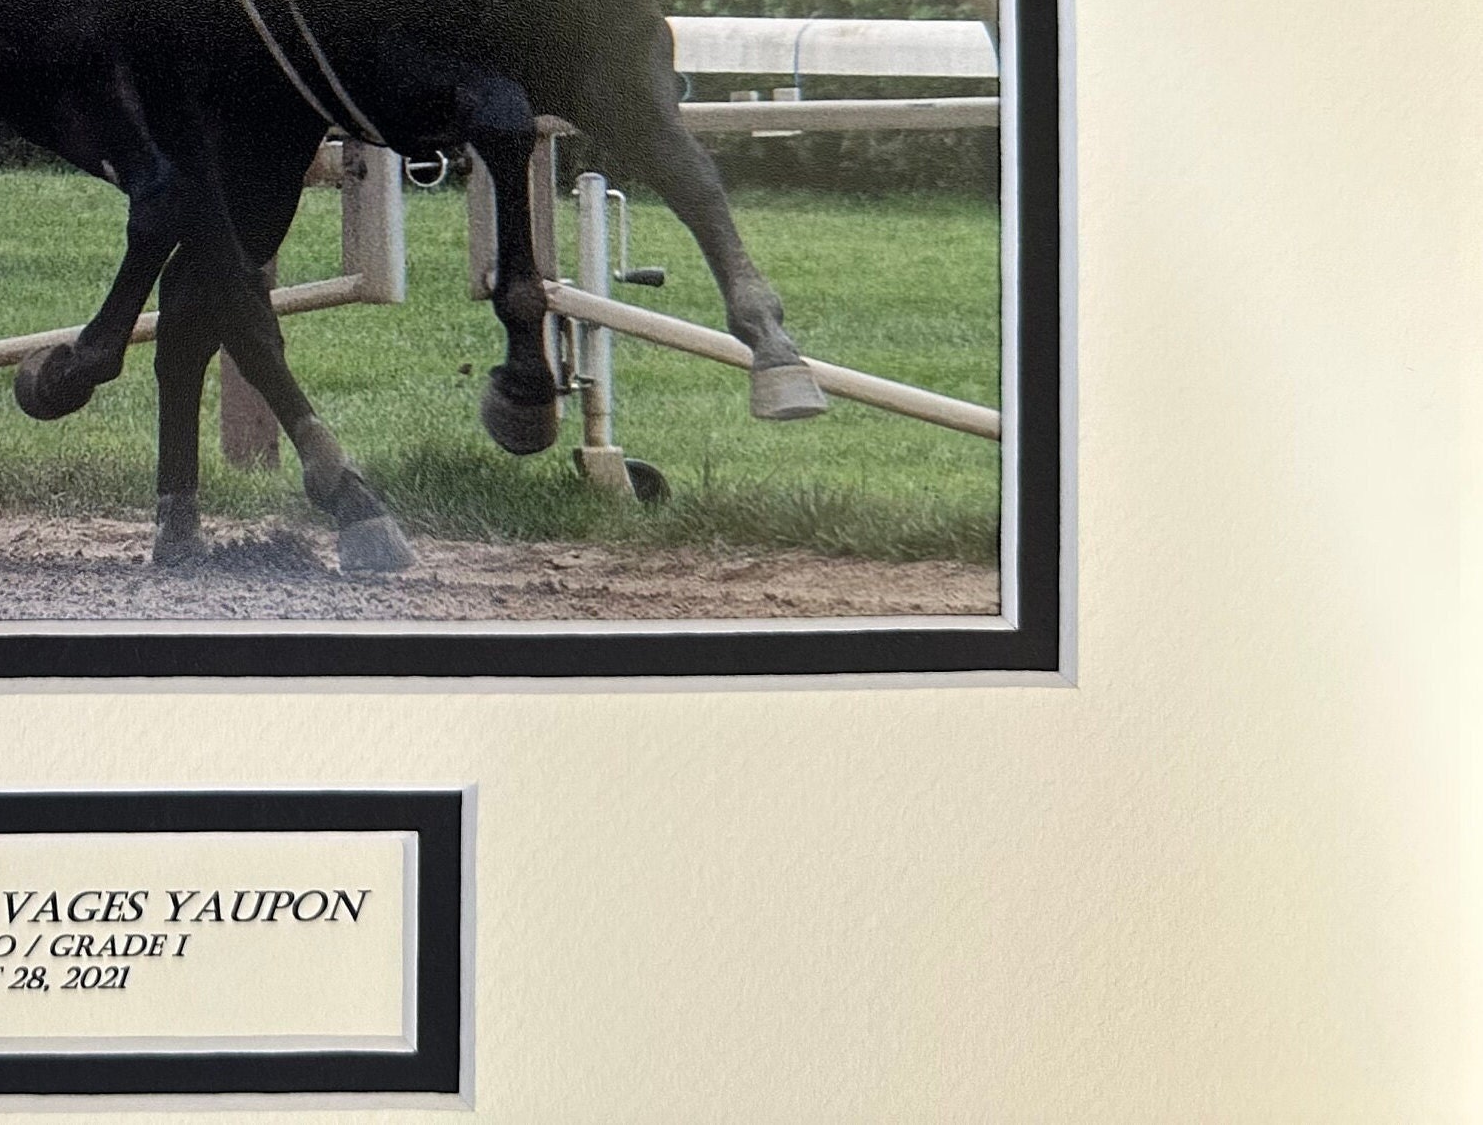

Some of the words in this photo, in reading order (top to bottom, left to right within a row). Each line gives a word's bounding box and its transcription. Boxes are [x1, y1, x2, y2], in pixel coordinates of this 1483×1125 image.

[163, 889, 372, 923] YAUPON
[23, 934, 43, 958] /
[49, 933, 168, 958] GRADE
[172, 933, 192, 958] I
[7, 966, 51, 993] 28,
[60, 965, 132, 990] 2021
